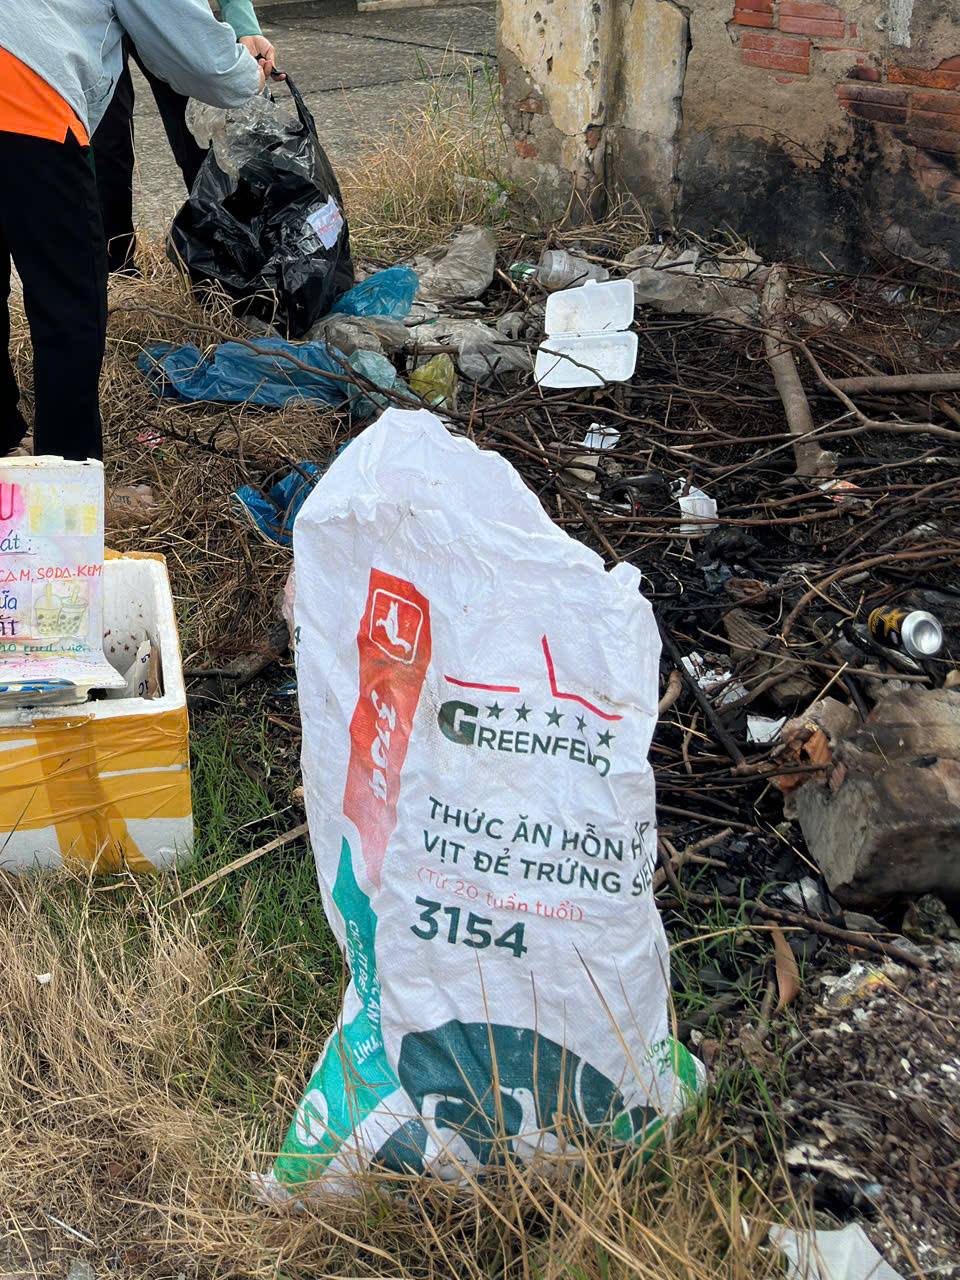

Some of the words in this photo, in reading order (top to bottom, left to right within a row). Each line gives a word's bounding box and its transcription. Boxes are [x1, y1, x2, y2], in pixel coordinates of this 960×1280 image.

[428, 795, 505, 840] THỨC
[511, 813, 553, 847] ĂN
[561, 821, 624, 862] HỖN
[416, 865, 449, 890] (Từ
[454, 879, 479, 900] 20
[486, 889, 529, 913] tuần
[534, 900, 585, 922] tuổi)
[423, 829, 466, 864] VỊT
[473, 847, 511, 876] ĐẺ
[520, 852, 622, 894] TRỨNG
[410, 895, 528, 959] 3154
